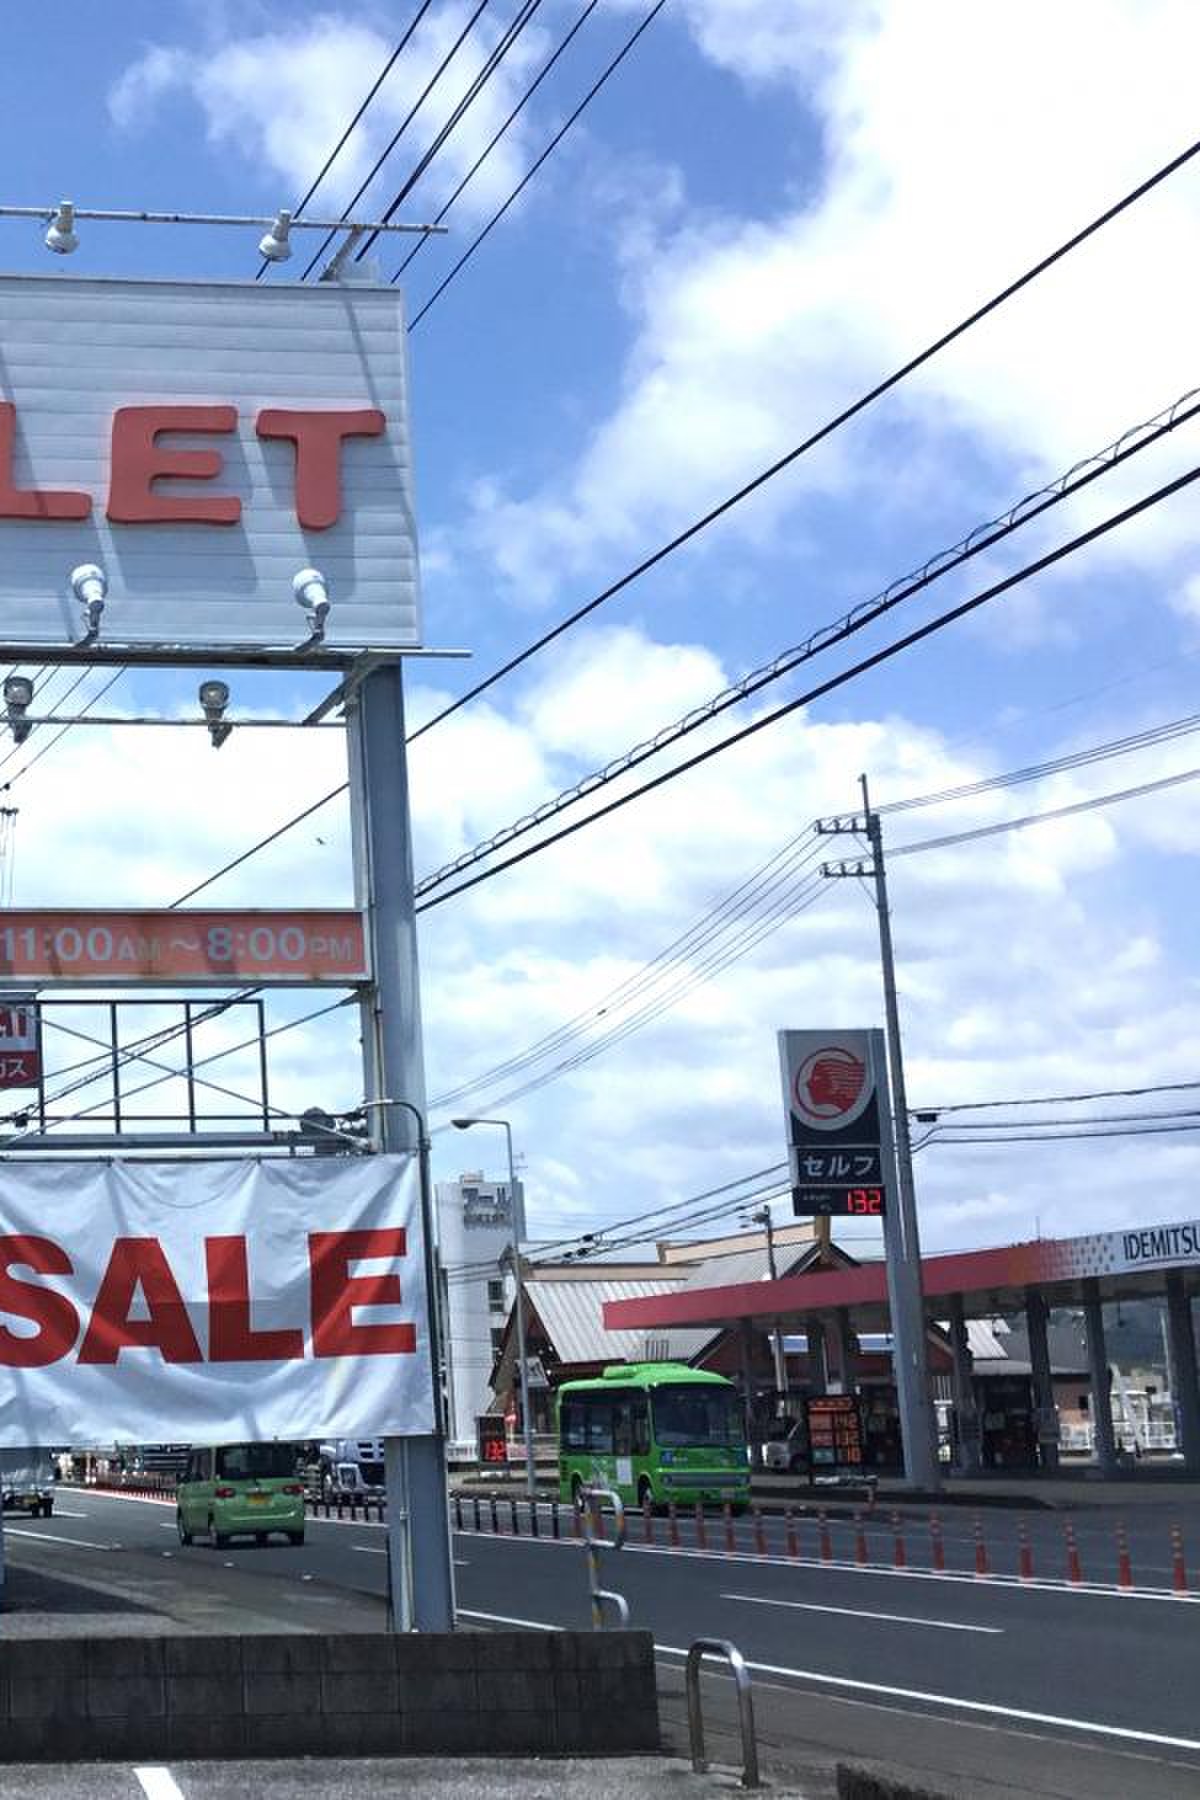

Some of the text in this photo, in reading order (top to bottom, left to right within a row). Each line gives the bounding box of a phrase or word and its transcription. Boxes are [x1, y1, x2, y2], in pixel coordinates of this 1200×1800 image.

[803, 1155, 875, 1178] セルフ
[847, 1189, 881, 1213] 132
